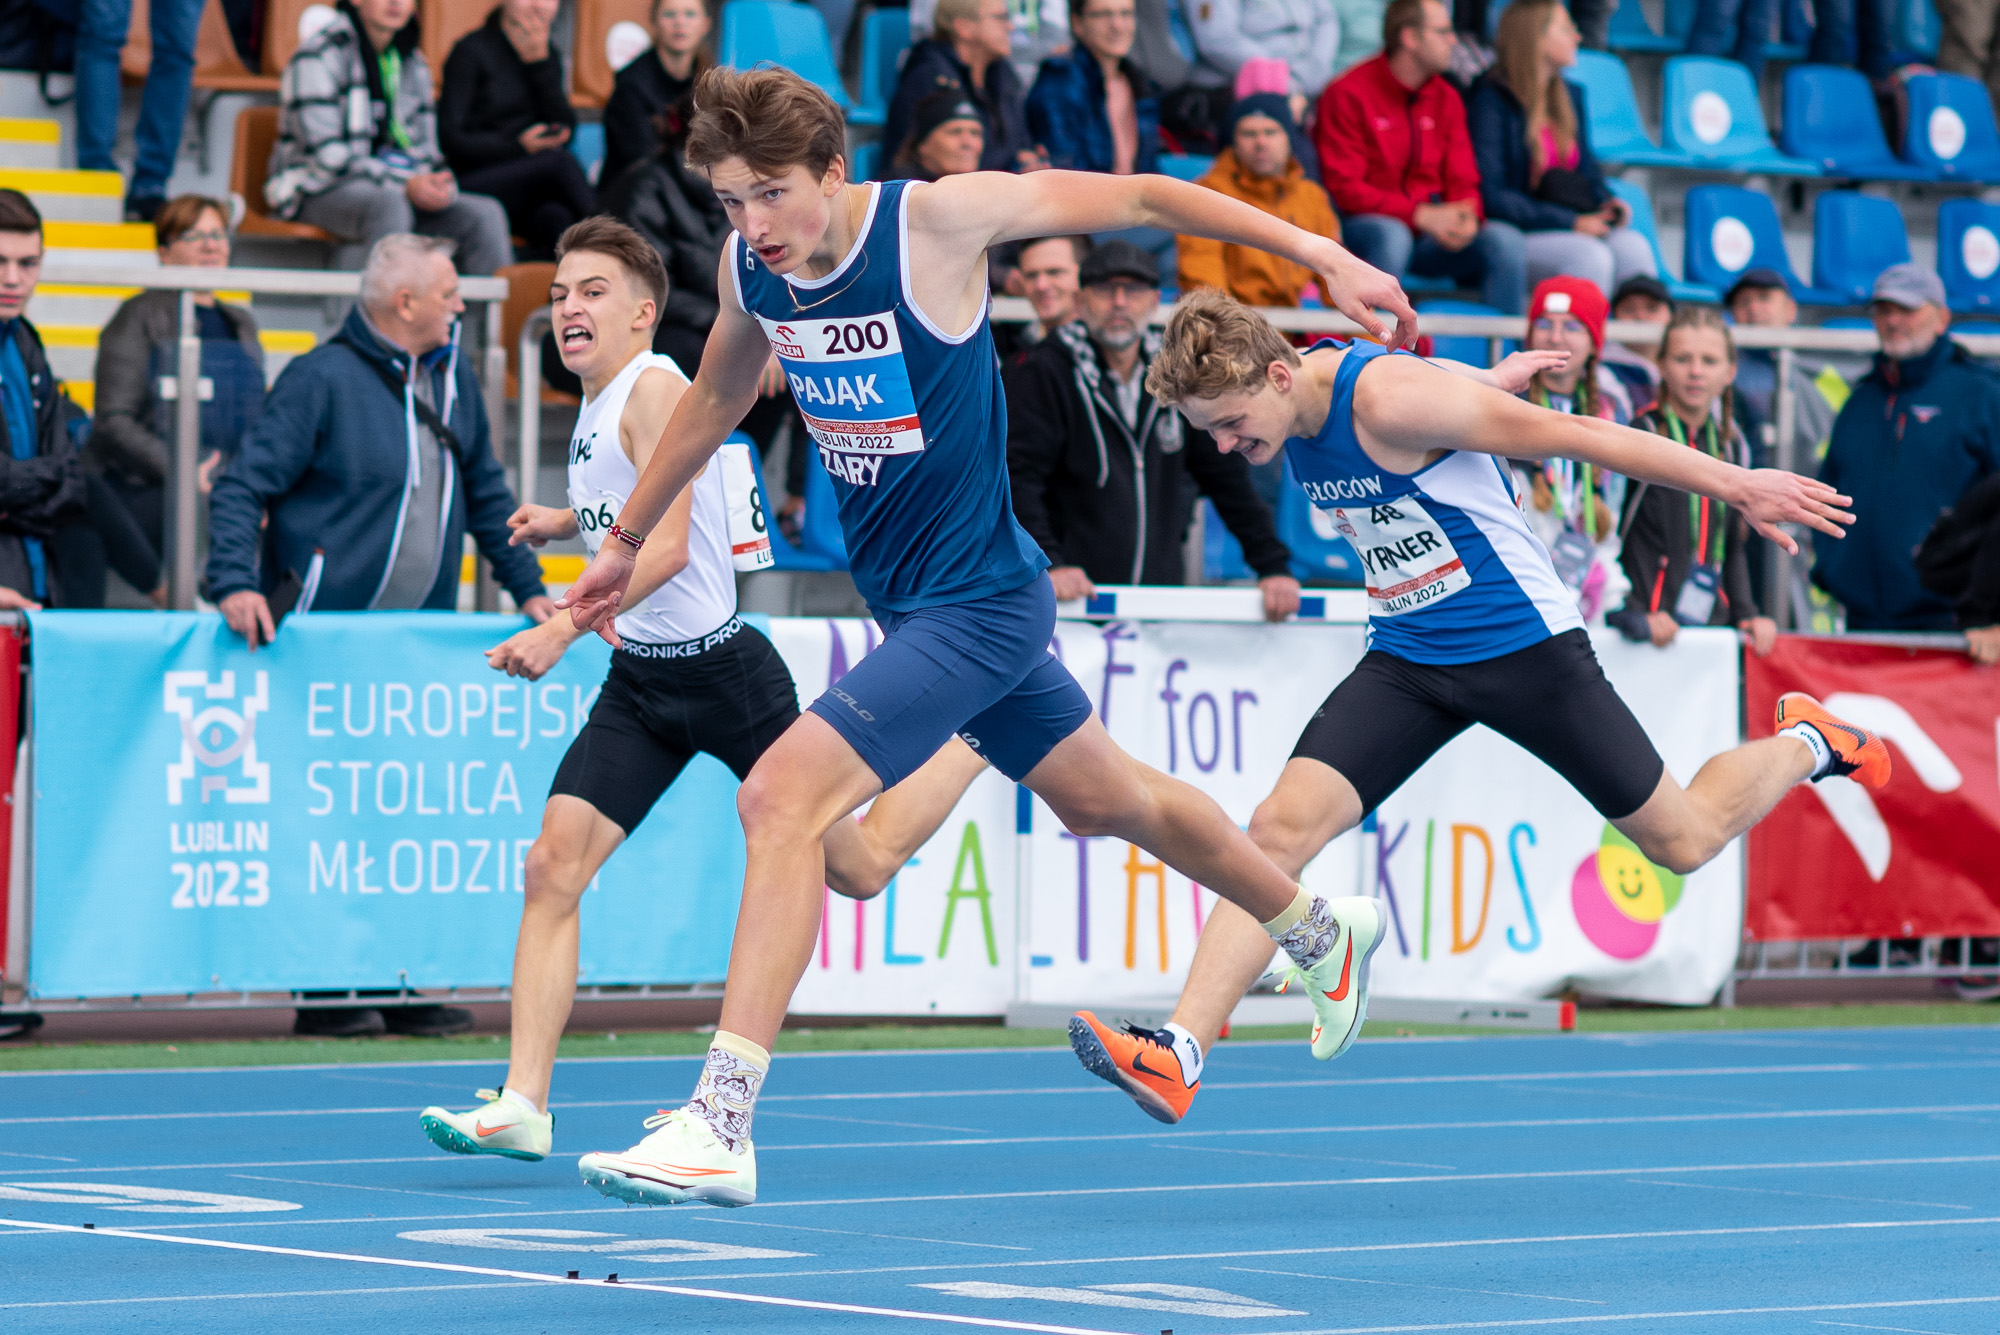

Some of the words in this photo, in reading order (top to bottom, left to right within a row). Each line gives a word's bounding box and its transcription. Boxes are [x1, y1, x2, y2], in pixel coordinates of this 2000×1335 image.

[822, 320, 888, 355] 200
[788, 372, 884, 411] PAJĄK
[570, 432, 597, 465] IK
[812, 427, 853, 448] LUBLIN
[855, 435, 894, 449] 2022
[750, 486, 765, 533] 8
[1370, 504, 1405, 526] 48
[1357, 530, 1442, 576] YRNER
[1414, 581, 1448, 604] 2022
[622, 640, 651, 658] PRO
[652, 640, 701, 659] NIKE
[704, 619, 741, 651] PRO
[308, 682, 600, 750] EUROPEJSK
[1160, 659, 1259, 774] for
[308, 761, 523, 815] STOLICA
[170, 821, 269, 853] LUBLIN
[170, 861, 270, 908] 2023
[308, 839, 599, 894] MŁODZIE
[1377, 818, 1541, 962] KIDS
